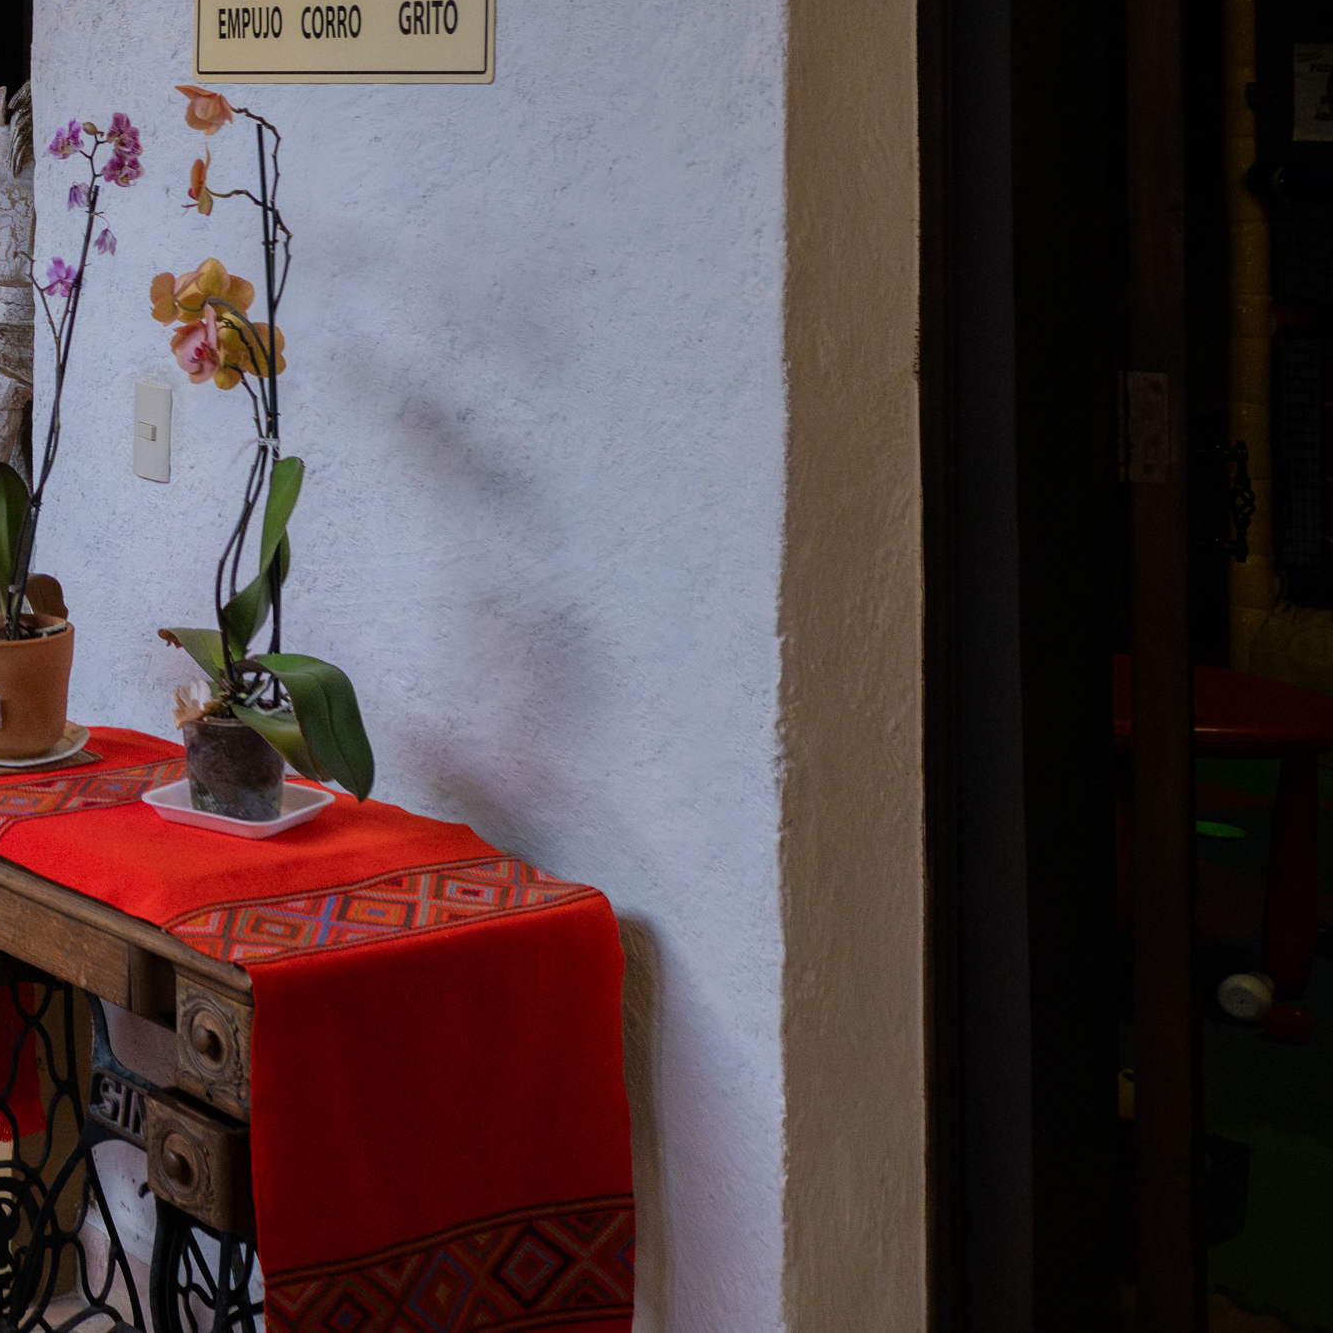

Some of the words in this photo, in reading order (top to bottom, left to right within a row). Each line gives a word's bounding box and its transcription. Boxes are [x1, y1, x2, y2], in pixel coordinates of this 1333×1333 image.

[218, 6, 282, 39] EMPUJO
[301, 4, 361, 39] CORRO
[399, 0, 458, 34] GRITO
[95, 1076, 147, 1140] SIN
